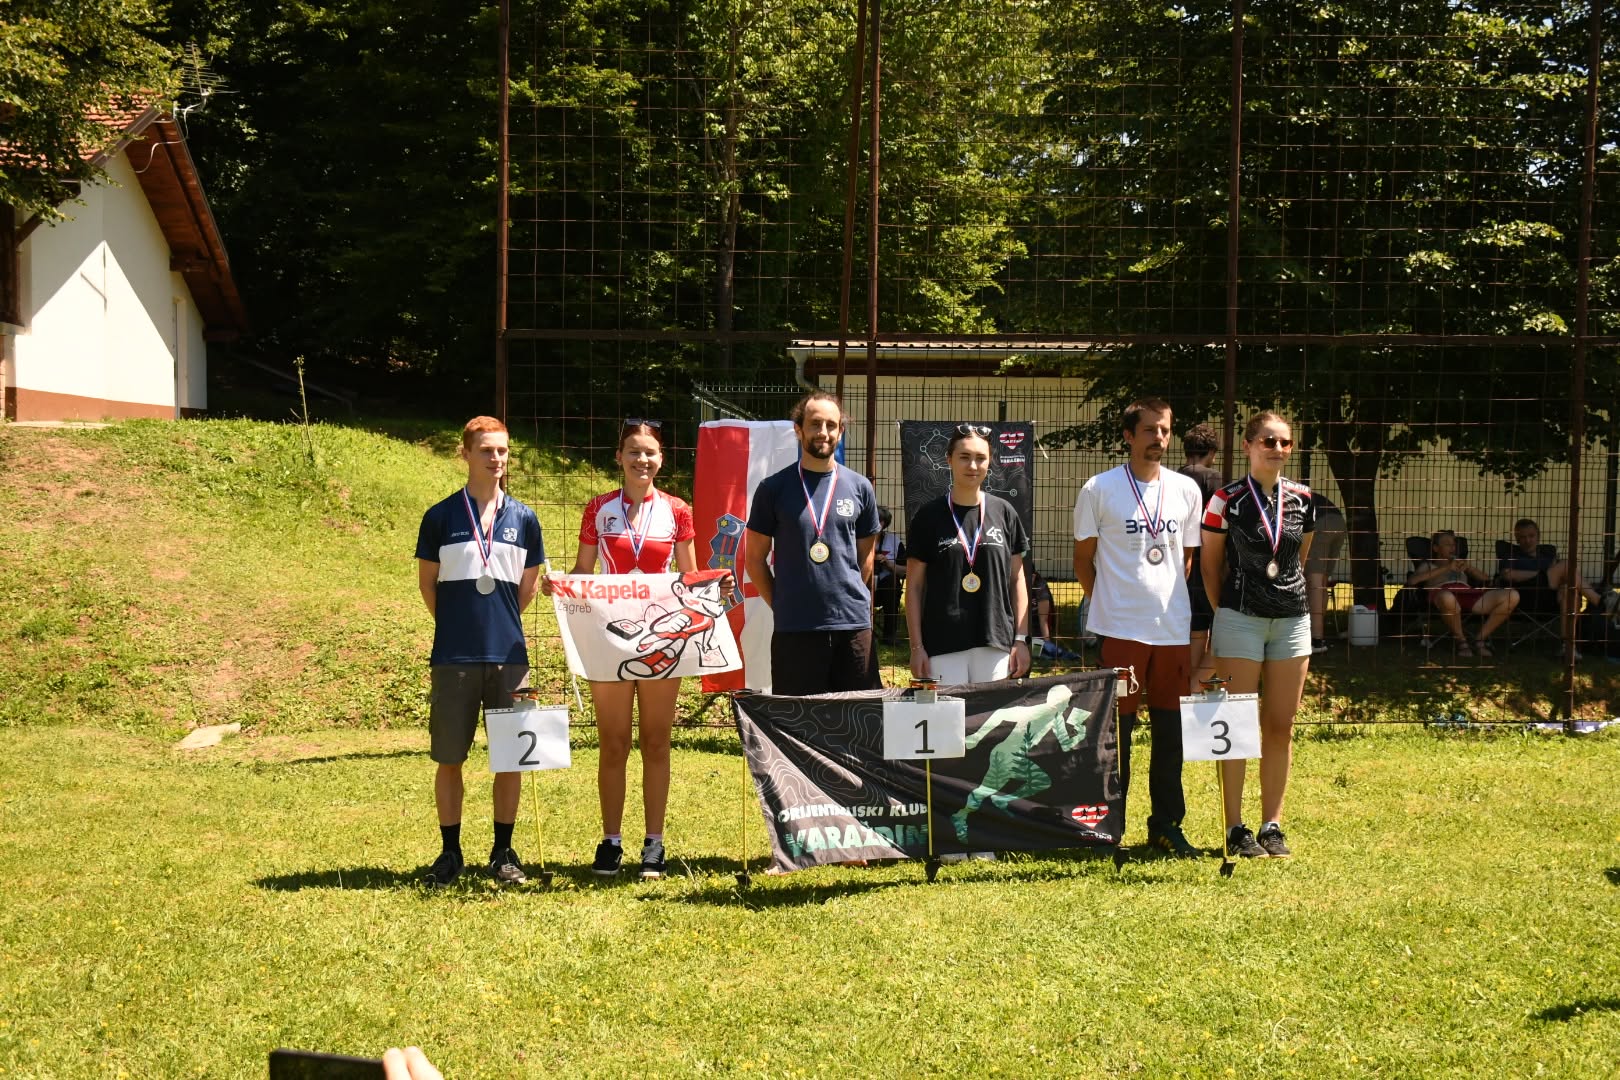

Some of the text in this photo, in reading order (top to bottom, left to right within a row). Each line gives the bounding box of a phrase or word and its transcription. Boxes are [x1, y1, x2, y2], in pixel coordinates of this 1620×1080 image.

[558, 600, 592, 614] Zagreb
[581, 580, 651, 604] Kapela
[518, 730, 540, 766] 2
[914, 719, 935, 754] 1
[1210, 720, 1232, 755] 3
[889, 803, 928, 817] KLUB
[784, 820, 928, 858] VARAŽDIN
